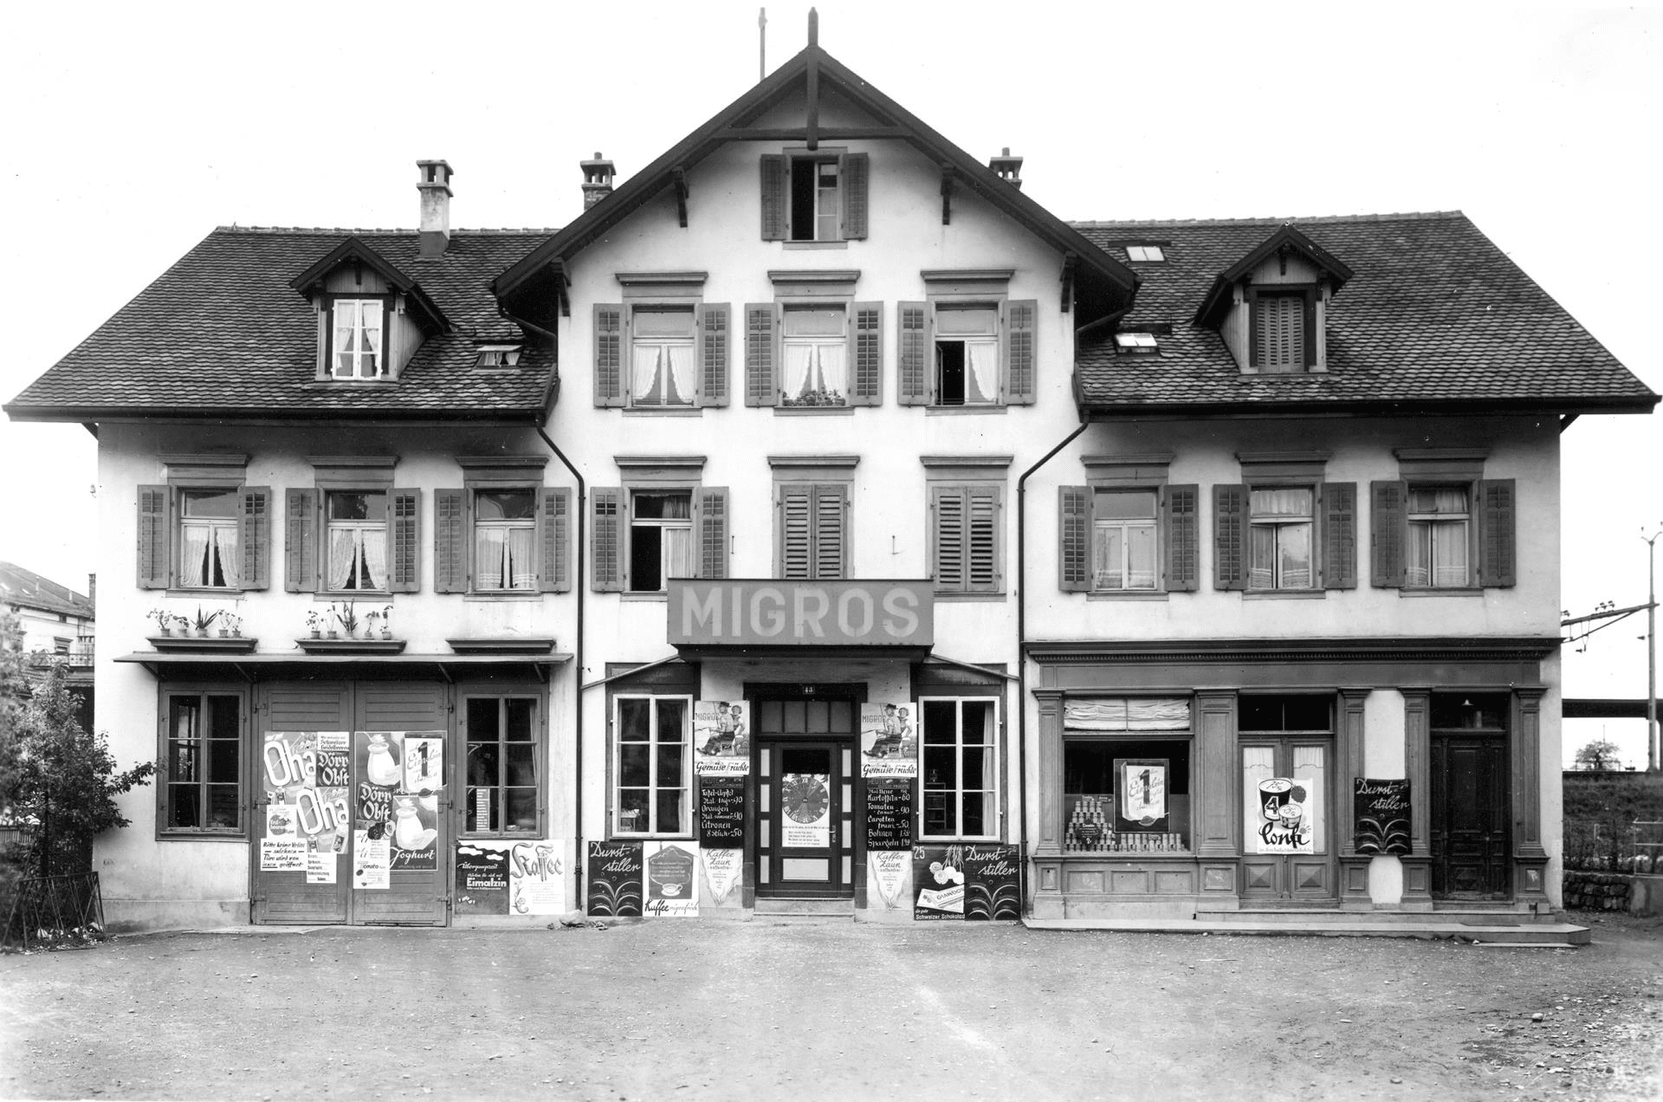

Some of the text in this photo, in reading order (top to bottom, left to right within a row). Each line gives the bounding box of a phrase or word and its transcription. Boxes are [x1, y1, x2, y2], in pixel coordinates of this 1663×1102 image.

[682, 586, 919, 637] MIGROS
[264, 739, 315, 786] Oha
[418, 741, 428, 777] 1
[1139, 769, 1150, 804] 1
[296, 787, 349, 834] Oha
[510, 842, 563, 882] Kaffee
[706, 849, 735, 859] Kaffee
[876, 851, 905, 862] Kaffee
[913, 846, 925, 859] 25
[466, 877, 507, 887] Eimalzin
[645, 899, 669, 916] Kaffee
